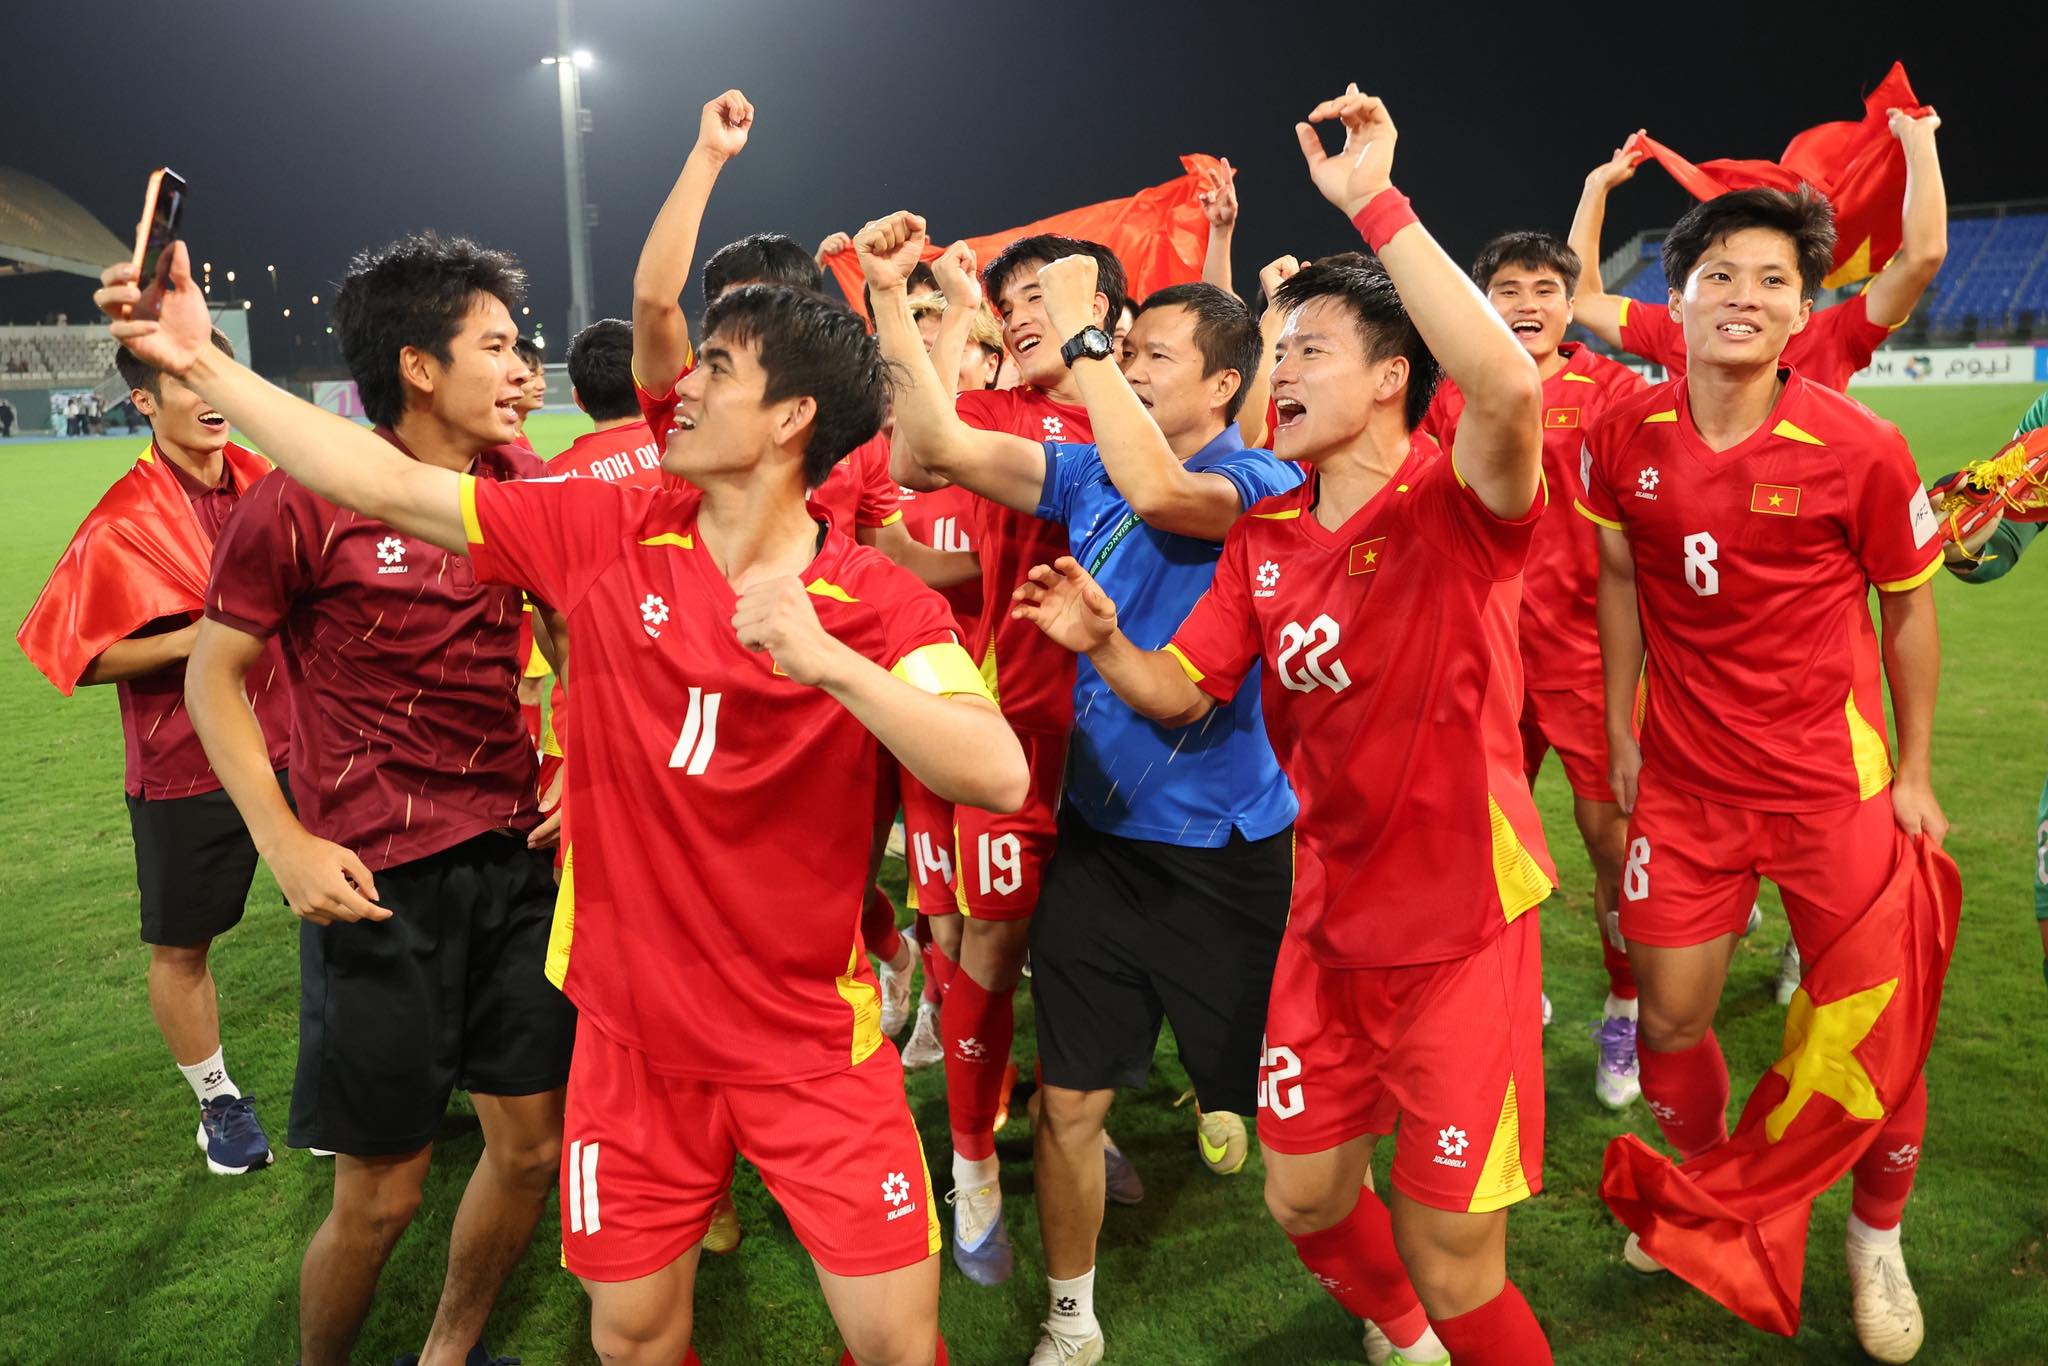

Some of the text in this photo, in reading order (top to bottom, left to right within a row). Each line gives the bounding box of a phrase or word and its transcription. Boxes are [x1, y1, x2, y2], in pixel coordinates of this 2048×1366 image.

[1945, 354, 2011, 377] نيوم
[1683, 531, 1719, 596] 8
[1277, 613, 1352, 694] 22
[668, 687, 722, 775] 11
[913, 831, 952, 886] 14
[978, 832, 1022, 896] 19
[1624, 836, 1651, 902] 8
[569, 1139, 601, 1236] 11
